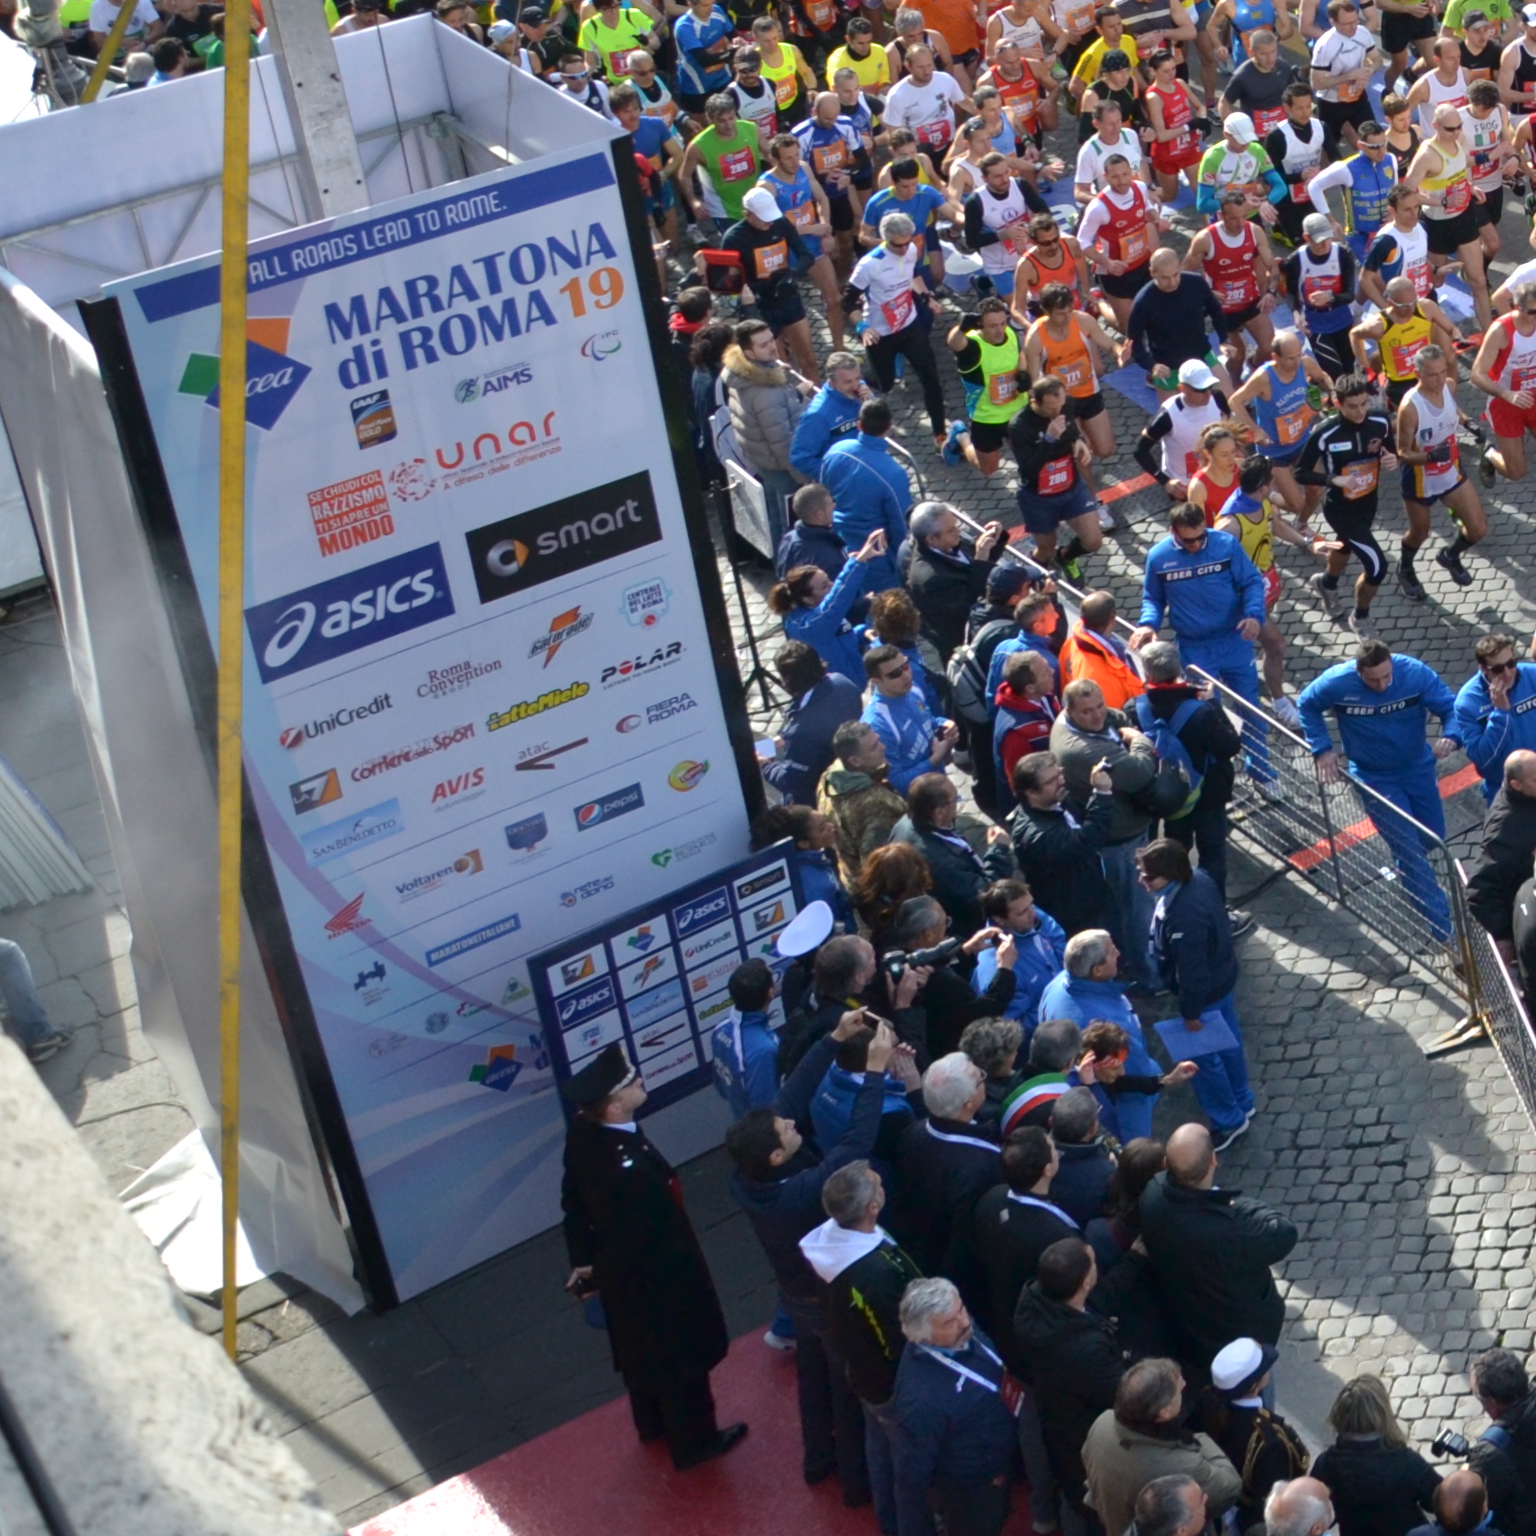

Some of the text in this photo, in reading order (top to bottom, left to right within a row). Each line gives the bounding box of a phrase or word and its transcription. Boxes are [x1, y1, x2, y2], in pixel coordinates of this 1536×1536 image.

[1473, 121, 1498, 133] FROG
[250, 190, 508, 284] ALL ROADS LEAD TO ROME.
[323, 222, 617, 344] MARATONA
[338, 267, 624, 390] di ROMA 19
[482, 367, 533, 397] AIMS
[436, 411, 555, 469] unar
[443, 444, 562, 491] A difesa delle differenze
[309, 473, 381, 504] SE CHIUDI COL
[312, 484, 385, 521] RAZZISMO
[316, 502, 388, 534] TI SI APRE UN
[536, 498, 642, 555] smart
[317, 514, 395, 558] MONDO
[1165, 563, 1221, 582] ESER CITO
[321, 568, 434, 638] asics
[627, 583, 661, 601] CENTRALE
[531, 613, 594, 655] Gatorade
[428, 660, 471, 684] Roma
[600, 641, 682, 683] POLAR
[417, 660, 503, 698] Convention
[303, 692, 393, 740] UniCredit
[487, 680, 590, 732] LatteMiele
[646, 692, 691, 715] FIERA
[647, 699, 698, 725] ROMA
[1345, 700, 1406, 716] ESER CITO
[516, 740, 550, 761] atac
[431, 766, 485, 804] AVIS
[604, 791, 638, 814] pepsi
[395, 865, 454, 894] Voltaren
[693, 898, 726, 920] asics
[695, 931, 732, 953] UniCredit
[578, 987, 611, 1012] asics
